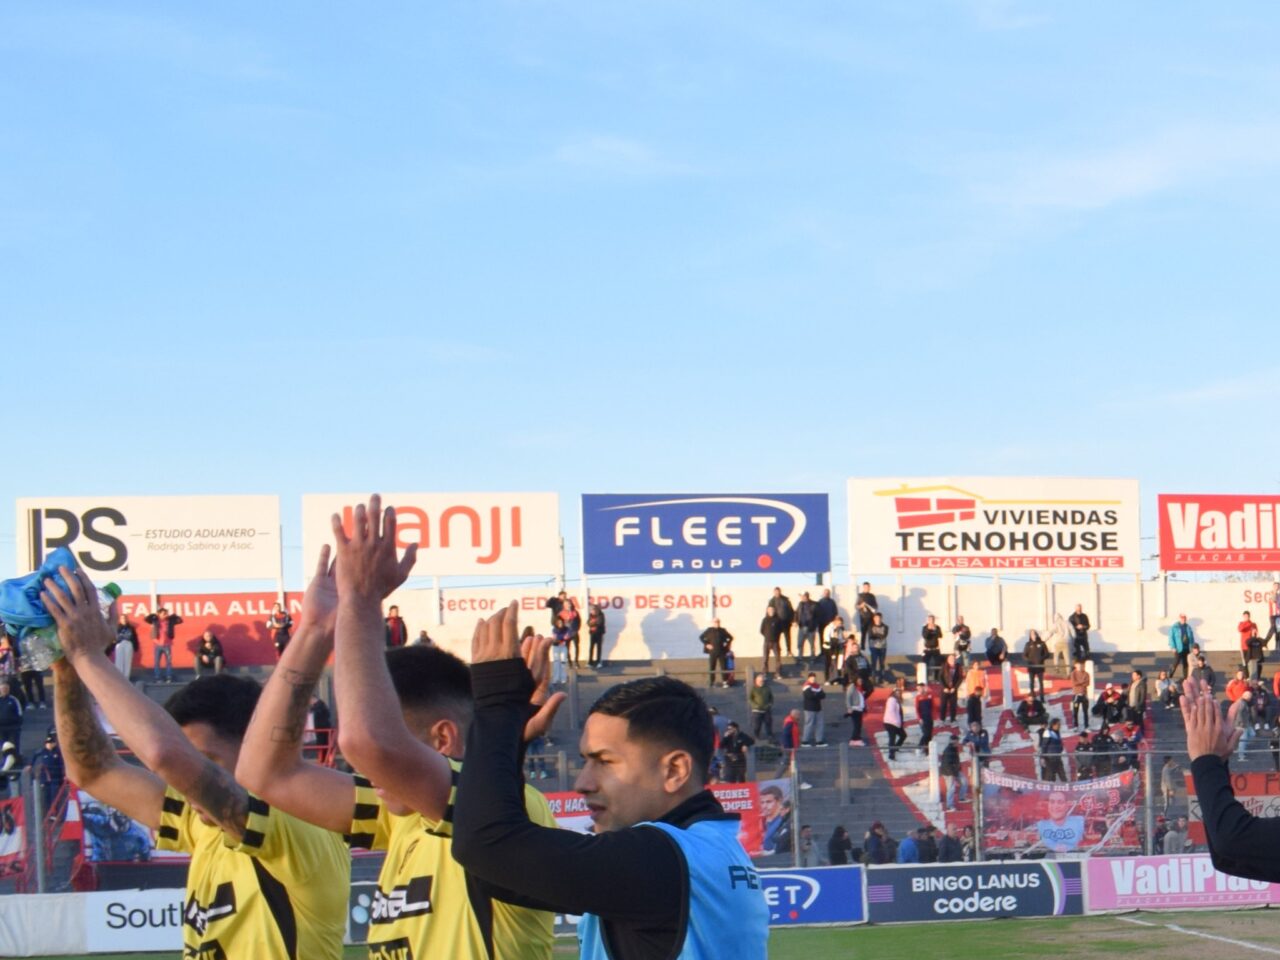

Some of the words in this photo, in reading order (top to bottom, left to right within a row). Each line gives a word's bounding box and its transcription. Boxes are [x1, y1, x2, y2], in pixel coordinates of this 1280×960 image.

[983, 510, 1118, 525] VIVIENDAS
[145, 529, 193, 540] ESTUDIO
[194, 528, 256, 539] ADUANERO
[614, 517, 777, 546] FLEET
[147, 541, 186, 552] Rodrigo
[186, 541, 220, 551] Sabino
[895, 531, 1119, 551] TECNOHOUSE
[895, 557, 922, 568] TU
[928, 557, 984, 568] CASA
[989, 556, 1120, 568] INTELIGENTE
[1175, 553, 1245, 561] PLACAS
[1261, 553, 1267, 561] Y
[652, 559, 742, 569] GROUP
[912, 876, 973, 892] BINGO
[977, 873, 1040, 889] LANUS
[933, 891, 1018, 914] codere
